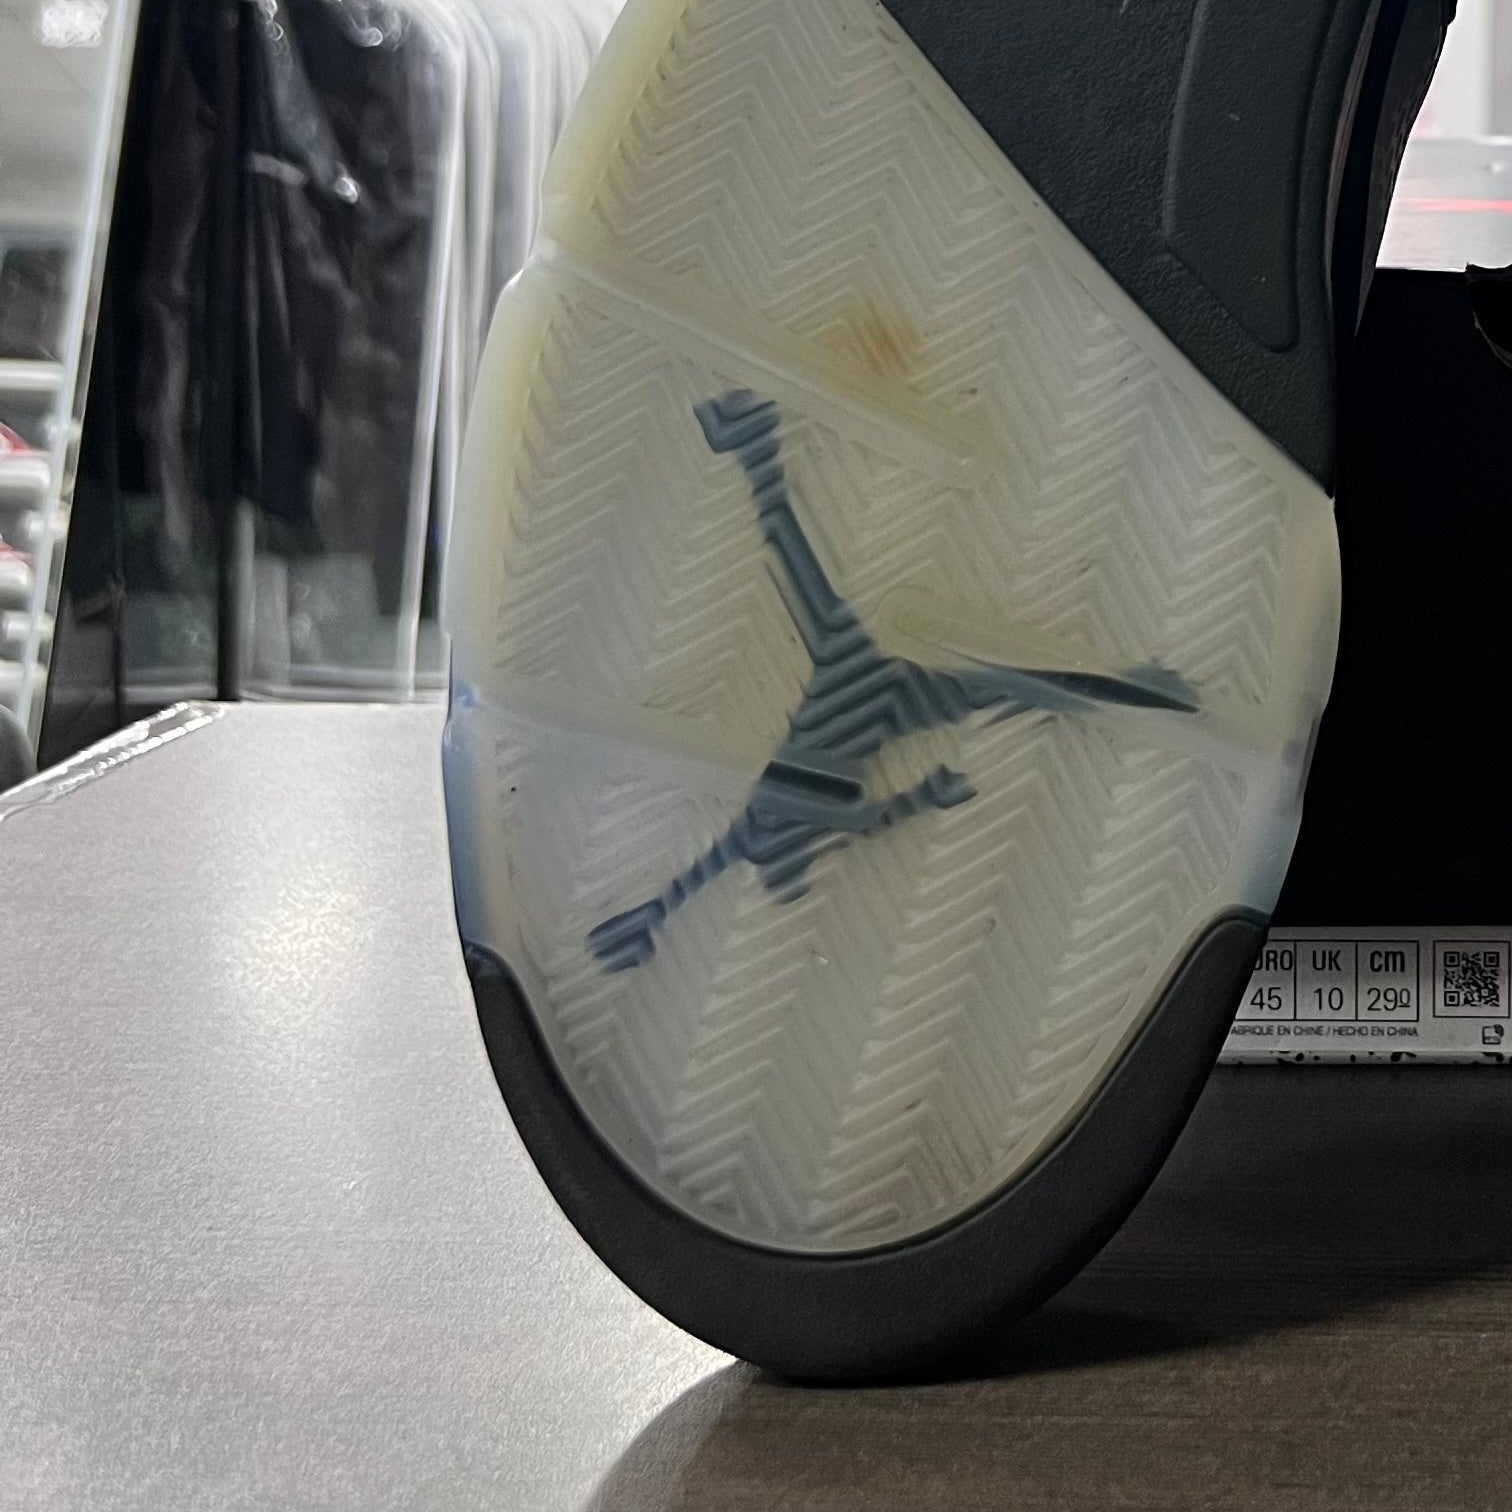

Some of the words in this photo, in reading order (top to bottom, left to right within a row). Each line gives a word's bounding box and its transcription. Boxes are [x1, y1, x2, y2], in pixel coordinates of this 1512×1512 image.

[1254, 949, 1293, 971] URO
[1311, 949, 1342, 972] UK
[1369, 950, 1406, 973] cm
[1250, 986, 1283, 1011] 45
[1313, 987, 1344, 1011] 10
[1231, 1025, 1274, 1037] ABRIQUE
[1276, 1025, 1291, 1037] EN
[1293, 1025, 1324, 1037] CHINE
[1332, 1025, 1369, 1037] HECHO
[1370, 1025, 1385, 1037] EN
[1386, 1025, 1419, 1037] CHINA
